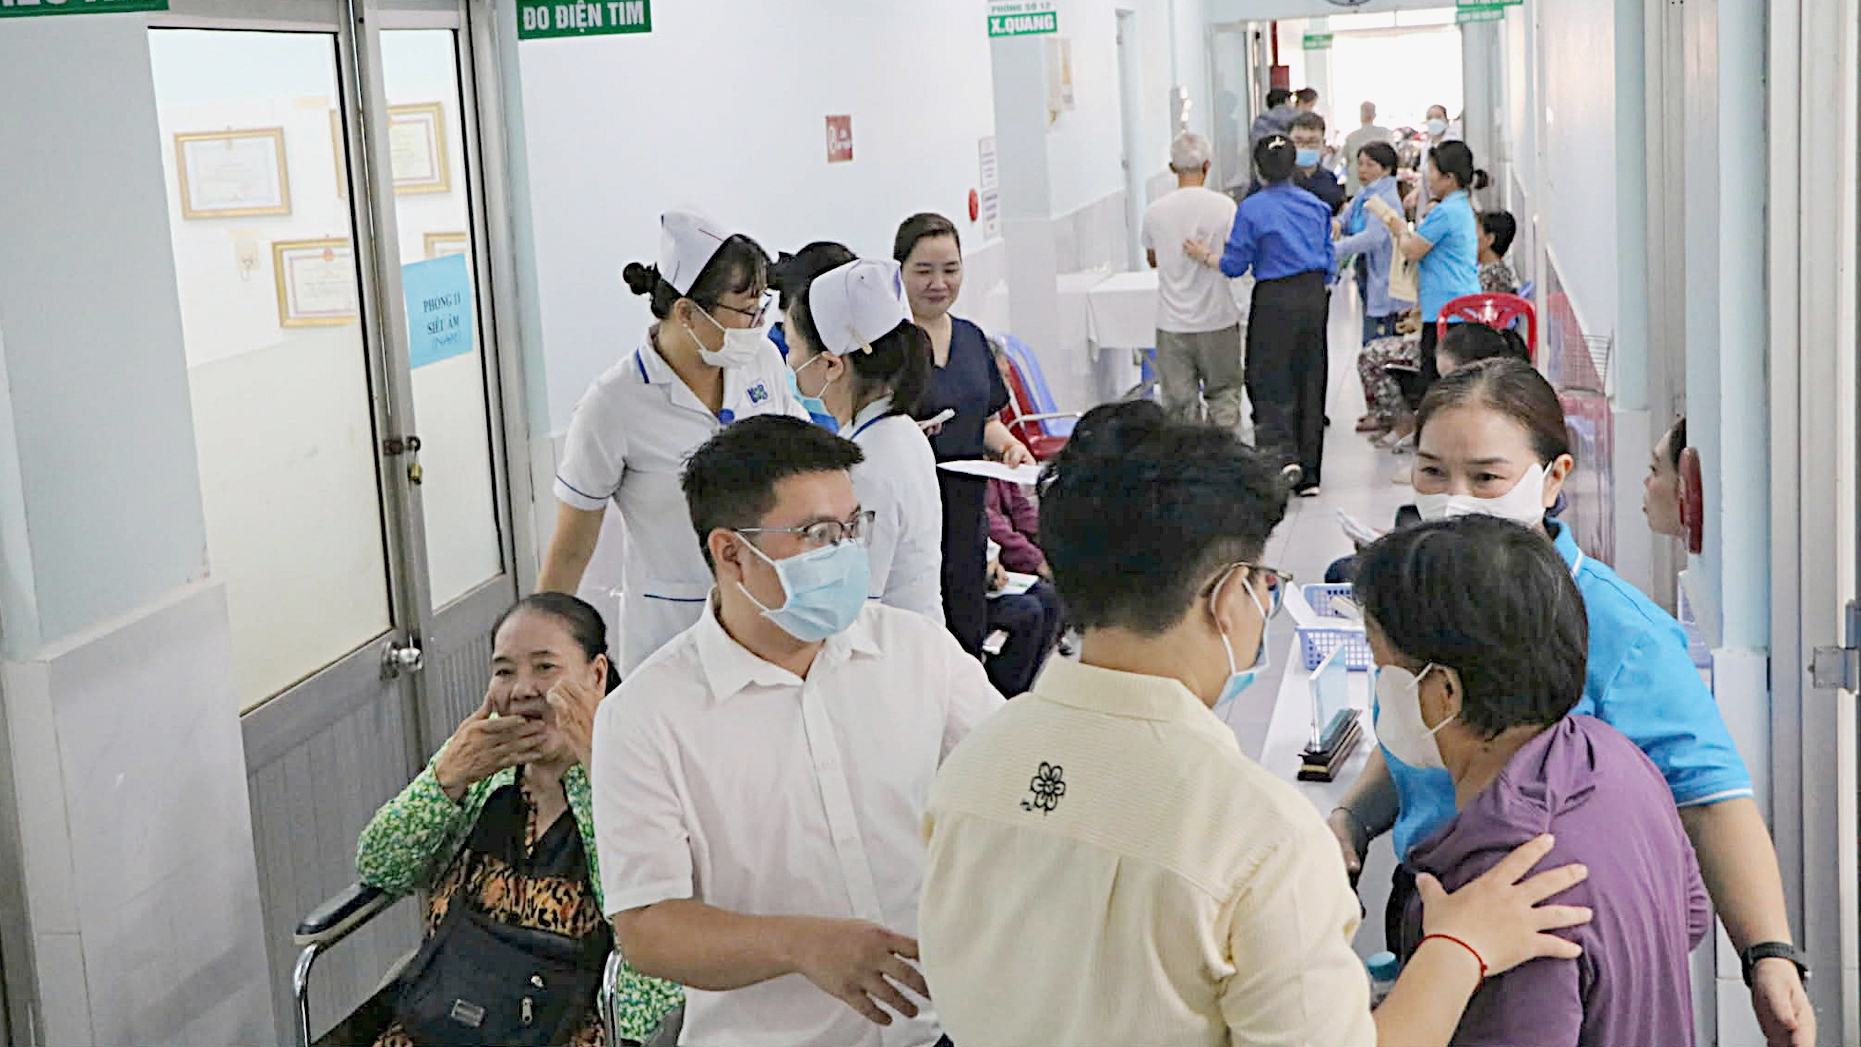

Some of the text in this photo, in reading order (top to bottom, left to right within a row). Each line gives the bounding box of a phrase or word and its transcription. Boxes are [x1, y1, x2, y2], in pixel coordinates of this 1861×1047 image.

[523, 0, 645, 33] ĐO ĐIỆN TIM
[991, 14, 1055, 34] X.QUANG
